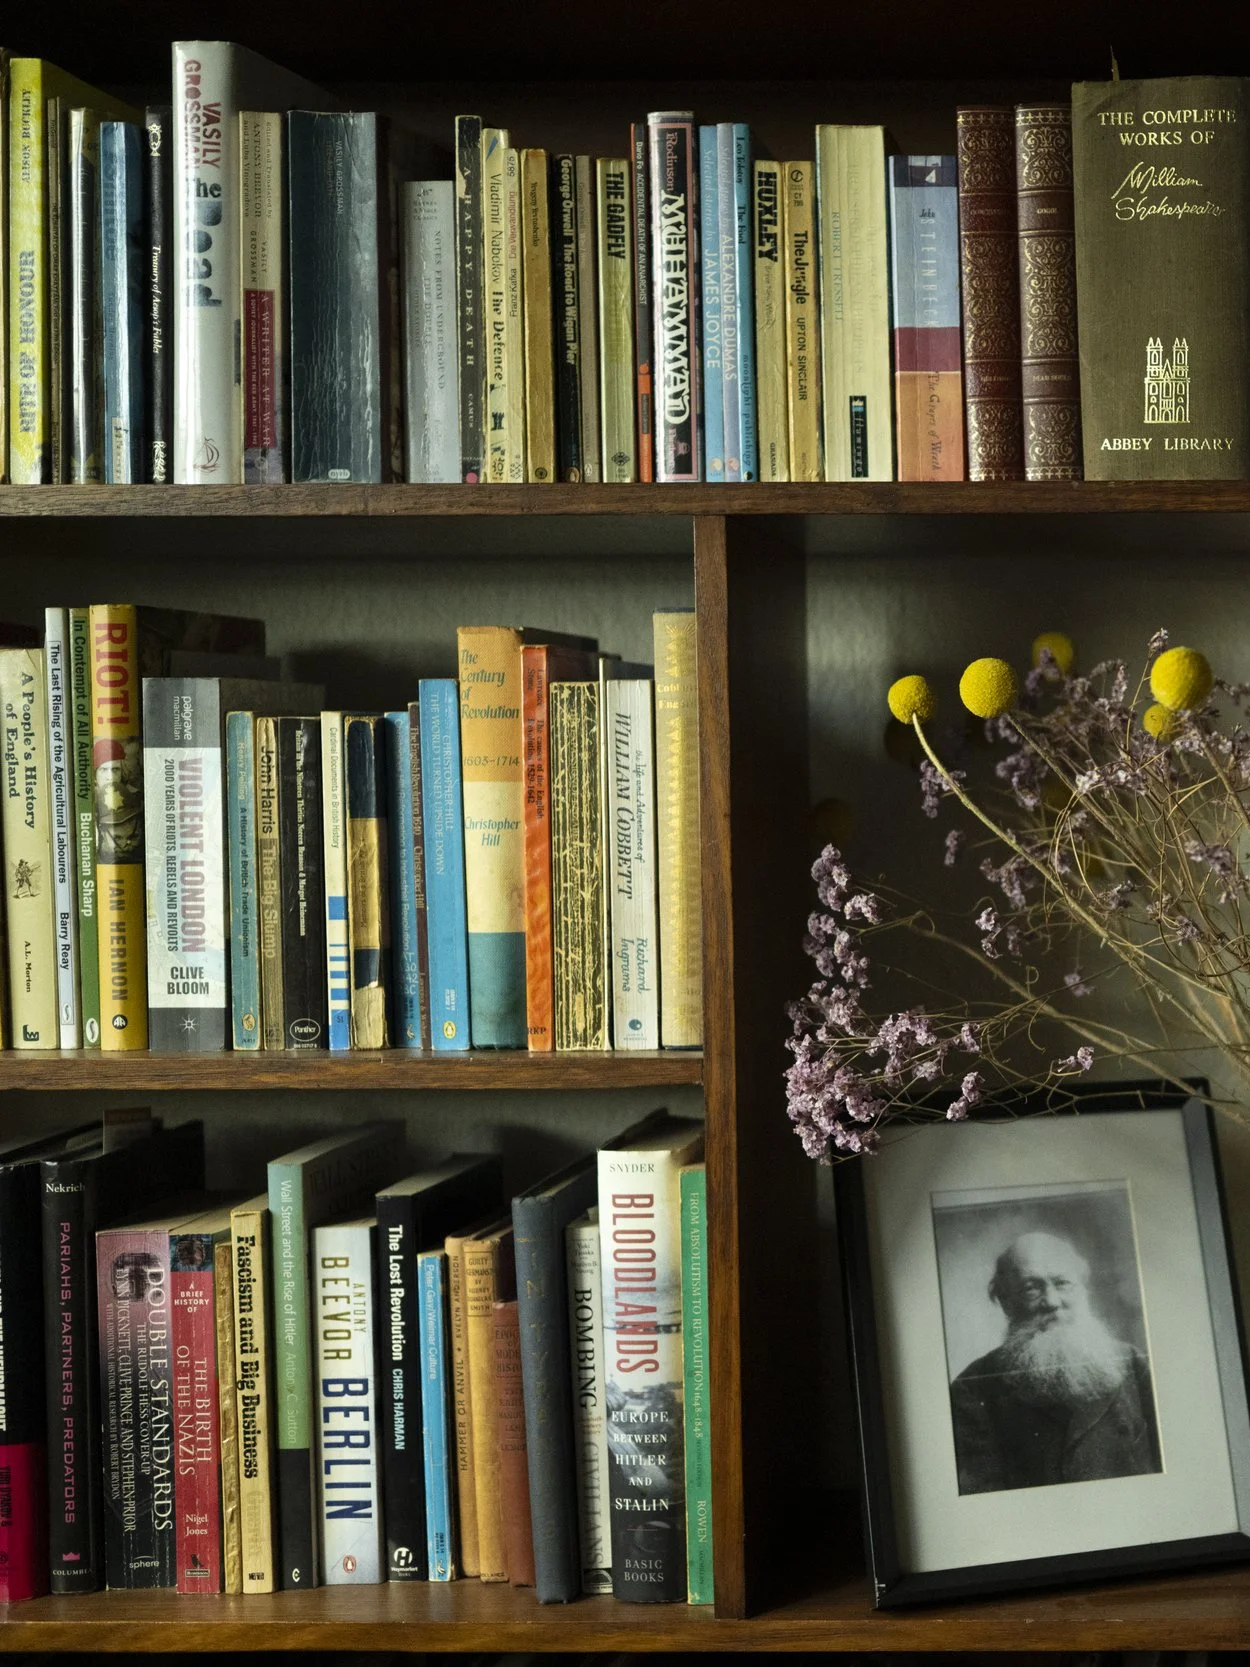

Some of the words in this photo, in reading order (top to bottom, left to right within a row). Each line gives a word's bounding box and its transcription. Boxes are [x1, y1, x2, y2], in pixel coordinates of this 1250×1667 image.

[184, 60, 201, 170] GROSSMAN
[202, 102, 220, 169] VASILY
[1098, 112, 1134, 126] THE
[1143, 109, 1236, 125] COMPLETE
[1119, 131, 1182, 146] WORKS
[1191, 131, 1215, 144] OF
[490, 173, 502, 225] Vladimir
[606, 172, 623, 199] THE
[1111, 162, 1202, 199] William
[606, 204, 624, 259] GADFLY
[757, 171, 777, 262] HUXLEY
[150, 245, 161, 282] Treasury
[492, 229, 504, 283] Nabokov
[705, 249, 719, 304] JAMES
[722, 235, 735, 325] ALEXANDRE
[149, 297, 161, 324] Aesop's
[151, 285, 161, 295] of
[660, 191, 688, 424] MUHAMMAD
[152, 327, 162, 353] Fables
[492, 321, 505, 380] Defence
[706, 311, 720, 368] JOYCE
[724, 327, 736, 380] DUMAS
[797, 317, 806, 351] UPTON
[798, 355, 807, 401] SINCLAIR
[1101, 438, 1152, 451] ABBEY
[1164, 438, 1234, 451] LIBRARY
[22, 673, 33, 684] A
[94, 623, 128, 724] RIOT!
[5, 703, 16, 719] of
[20, 692, 35, 761] People's
[6, 727, 19, 798] England
[615, 713, 631, 799] WILLIAM
[23, 766, 36, 828] History
[179, 758, 202, 854] VIOLENT
[80, 812, 92, 876] Buchanan
[617, 807, 633, 899] COBBETT
[81, 879, 94, 916] Sharp
[108, 879, 124, 911] IAN
[180, 860, 205, 952] LONDON
[58, 912, 69, 940] Barry
[59, 943, 70, 969] Reay
[110, 921, 127, 1000] HERNON
[170, 967, 204, 980] CLIVE
[620, 937, 634, 992] Ingrams
[636, 937, 648, 993] Richard
[167, 982, 209, 995] BLOOM
[608, 1164, 655, 1172] SNYDER
[58, 1222, 73, 1306] PARIAHS,
[389, 1225, 402, 1251] The
[390, 1254, 402, 1284] Lost
[611, 1194, 659, 1373] BLOODLANDS
[147, 1268, 168, 1369] DOUBLE
[321, 1257, 351, 1360] BEEVOR
[353, 1283, 365, 1332] ANTONY
[391, 1288, 404, 1360] Revolution
[60, 1312, 74, 1412] PARTNERS,
[392, 1368, 404, 1400] CHRIS
[322, 1378, 372, 1520] BERLIN
[393, 1402, 405, 1449] HARMAN
[61, 1417, 76, 1523] PREDATORS
[150, 1379, 172, 1531] STANDARDS
[696, 1500, 706, 1543] ROWEN
[624, 1573, 664, 1582] BOOKS
[625, 1559, 662, 1569] BASIC
